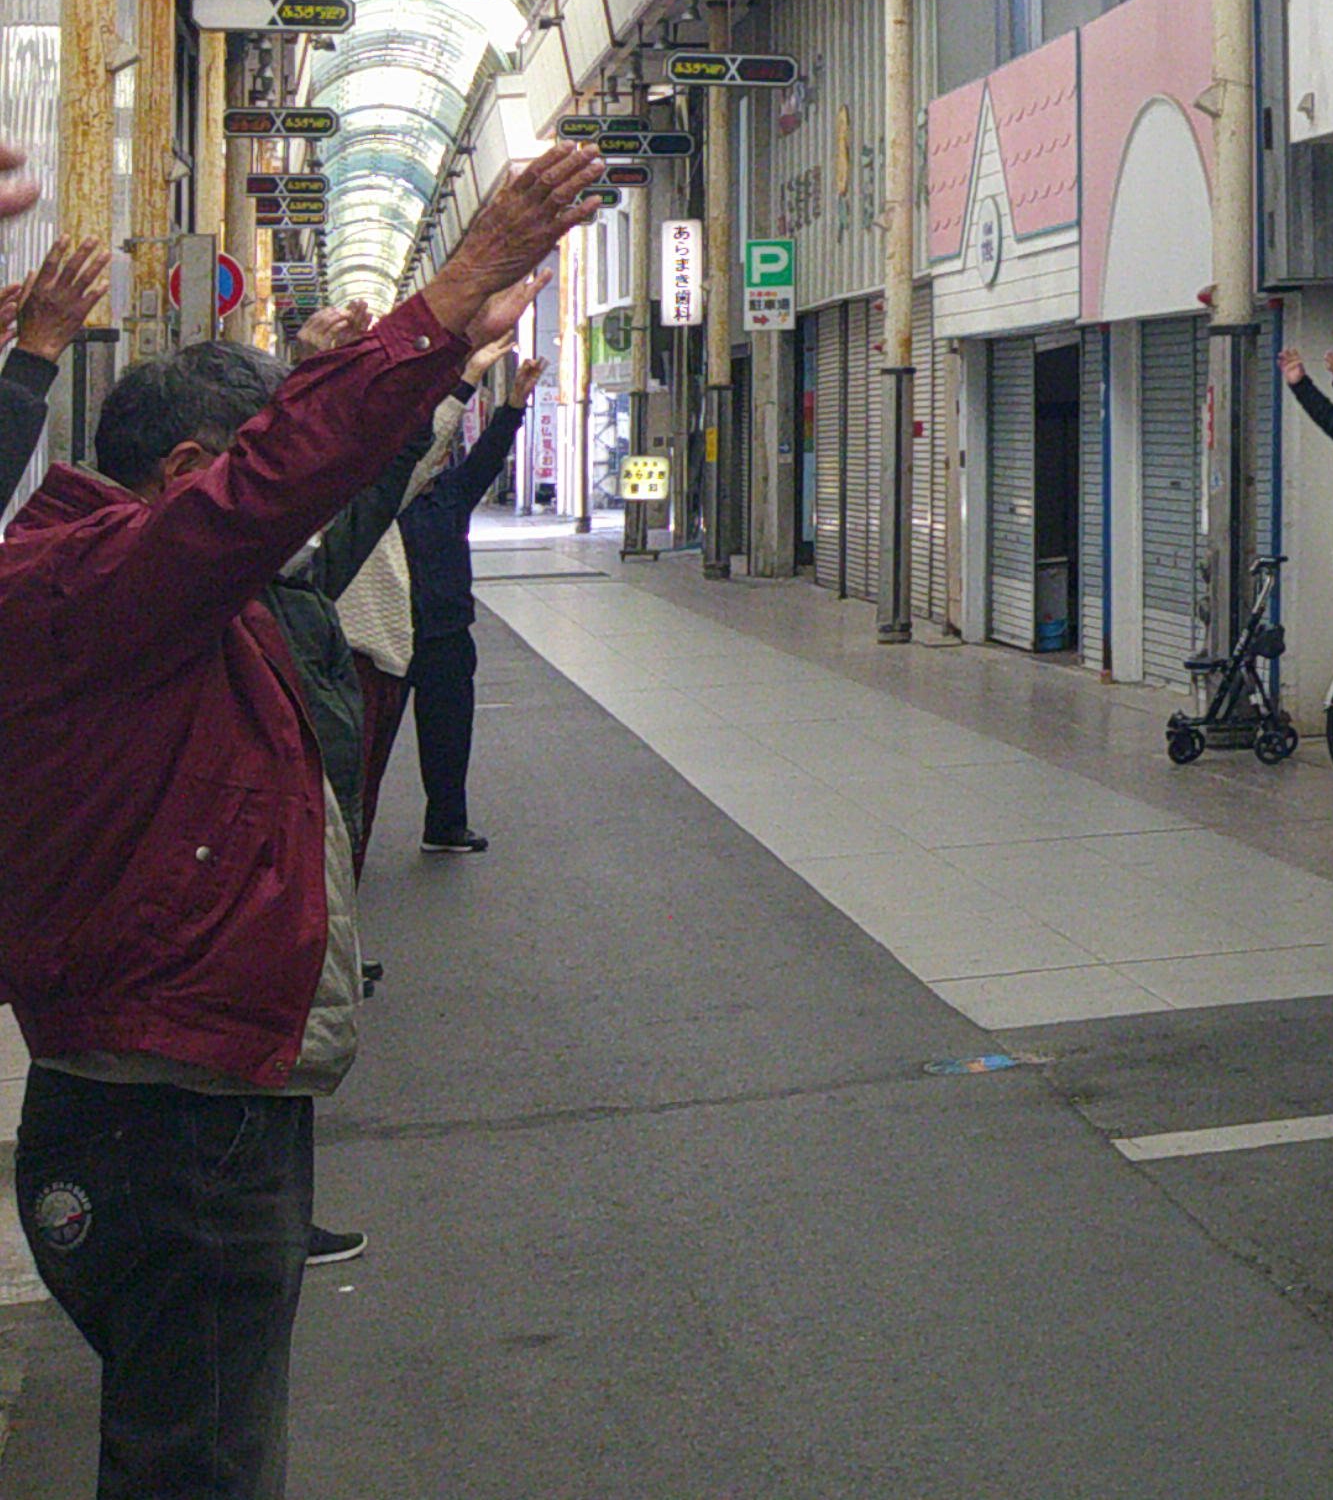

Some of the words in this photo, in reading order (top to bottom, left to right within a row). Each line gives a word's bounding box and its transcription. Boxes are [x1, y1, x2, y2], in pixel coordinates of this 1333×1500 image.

[673, 225, 692, 322] あらまき歯科
[751, 245, 790, 284] P
